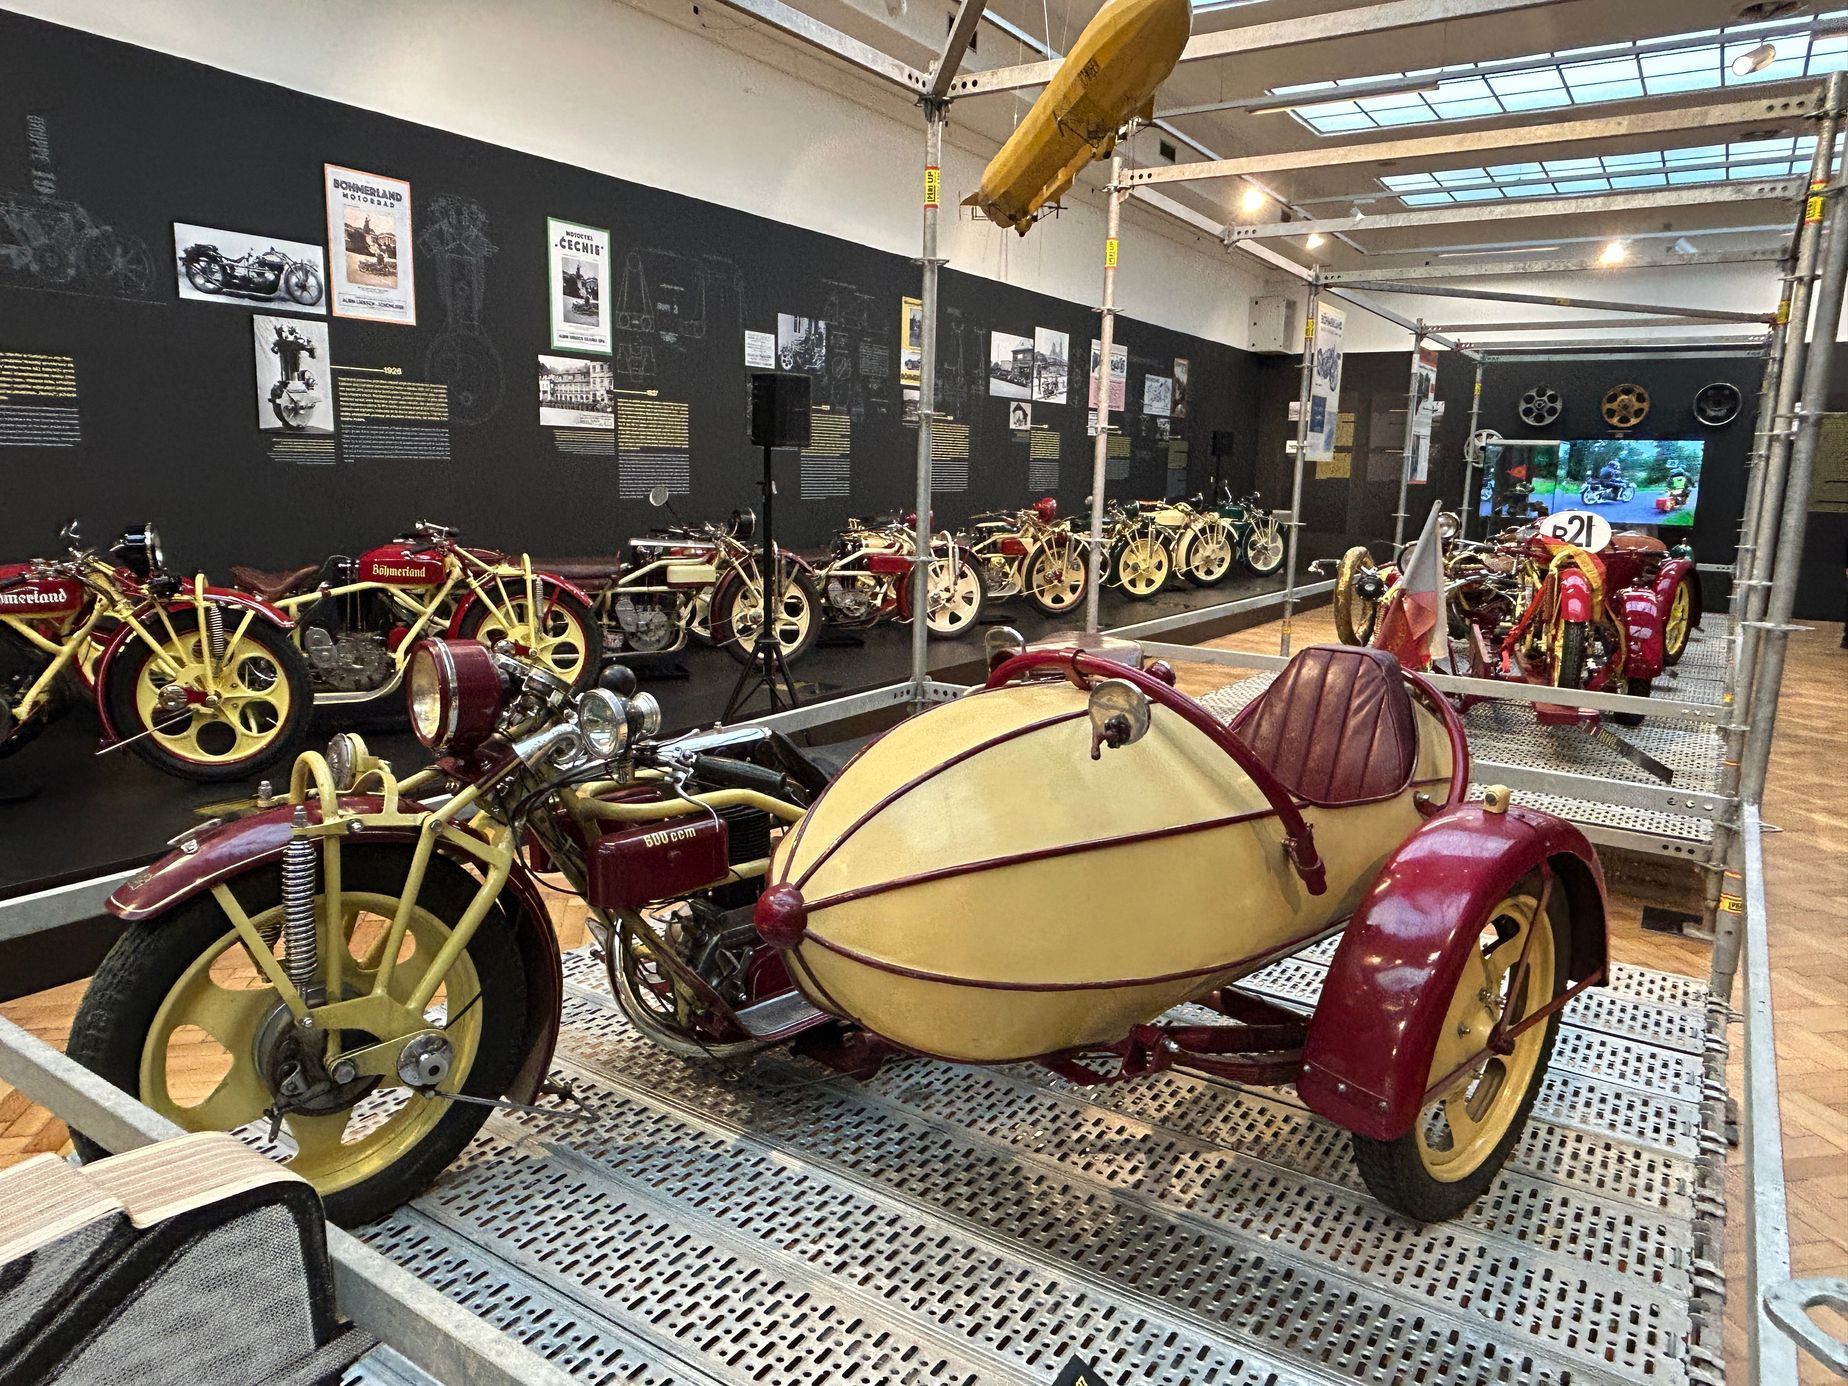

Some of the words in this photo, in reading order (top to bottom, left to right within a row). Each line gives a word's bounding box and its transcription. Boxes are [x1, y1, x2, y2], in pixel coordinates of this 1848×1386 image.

[927, 171, 934, 184] UP
[342, 192, 395, 208] MOTORRAD
[372, 563, 426, 578] Böhmerland
[0, 588, 67, 605] merland
[643, 831, 669, 848] 600
[670, 827, 696, 842] ccm
